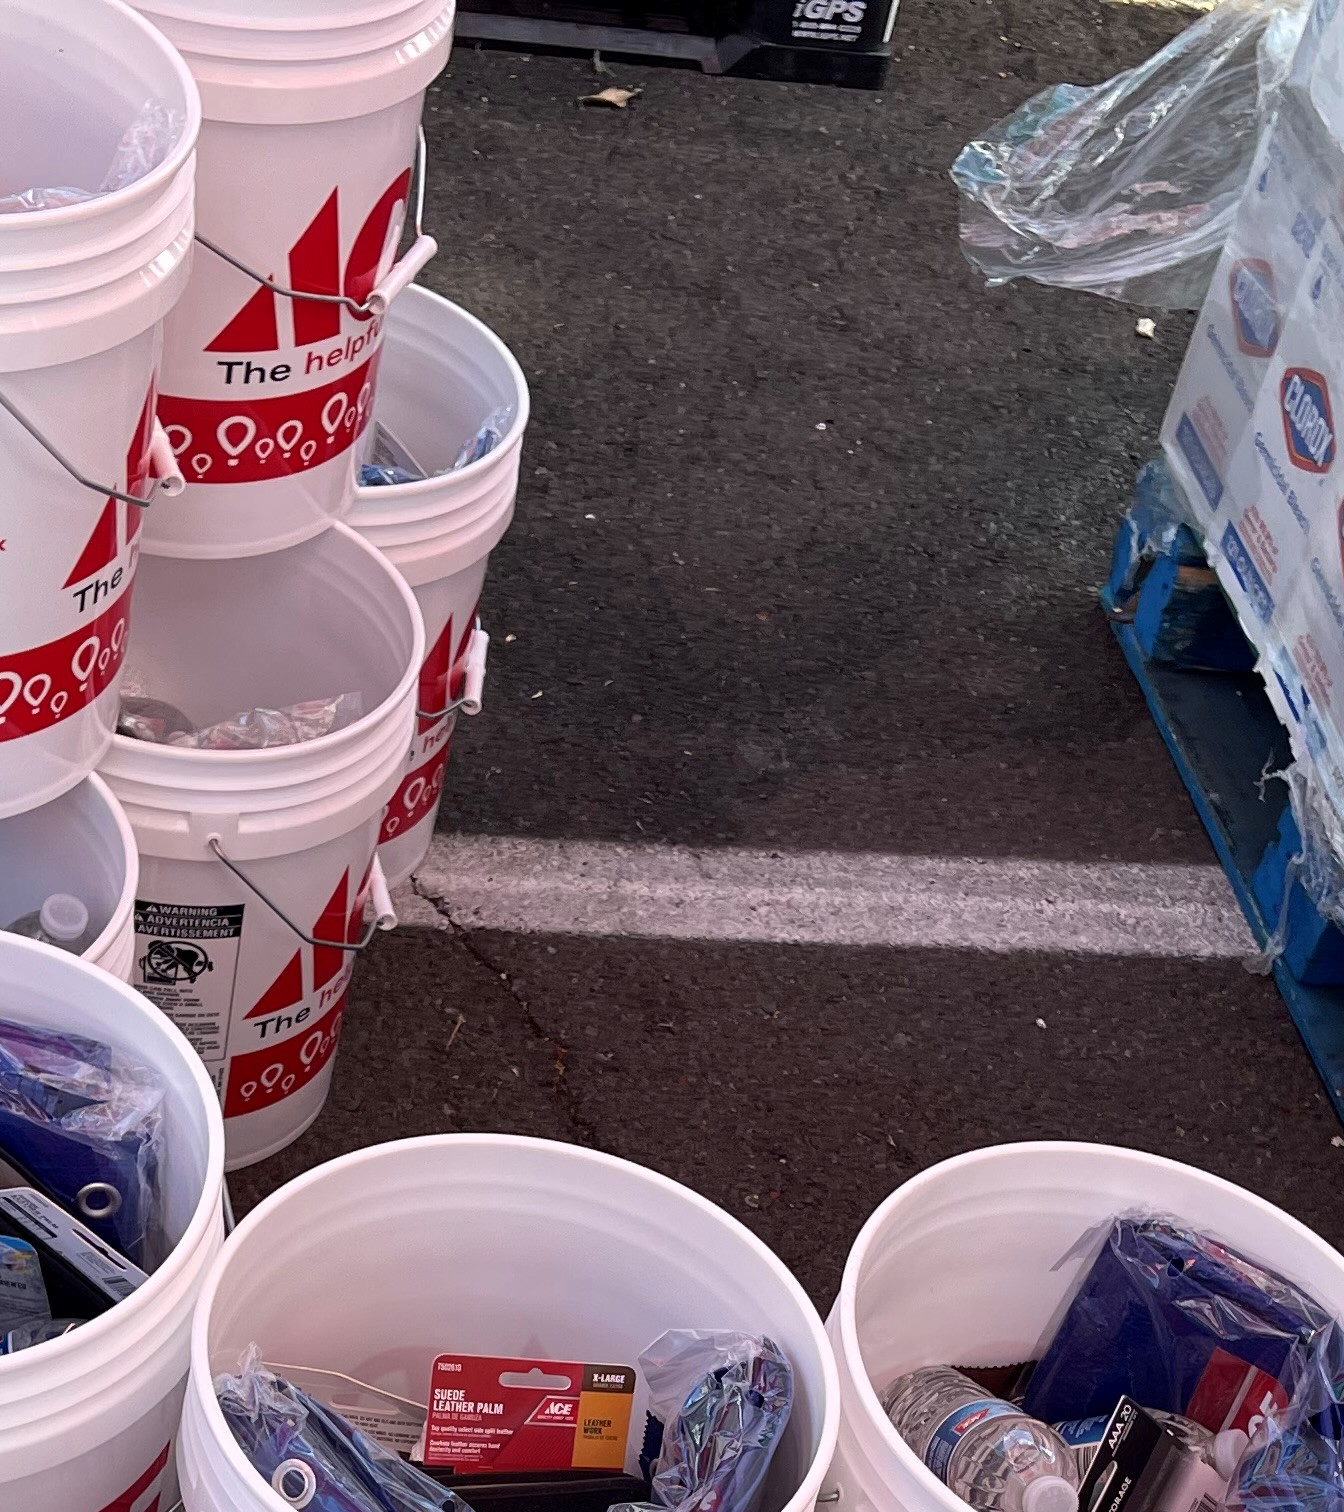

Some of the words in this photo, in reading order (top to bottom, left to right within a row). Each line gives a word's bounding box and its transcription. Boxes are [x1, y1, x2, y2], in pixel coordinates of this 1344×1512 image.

[217, 361, 292, 385] The
[1284, 373, 1336, 468] CLOROX
[73, 566, 124, 614] The
[158, 906, 218, 917] WARNING
[146, 915, 230, 928] ADVERTENCIA
[137, 925, 235, 938] AVERTISSEMENT
[253, 1007, 311, 1038] The
[592, 1373, 626, 1385] X-LARGE
[434, 1388, 466, 1401] SUEDE
[432, 1399, 474, 1413] LEATHER
[476, 1402, 504, 1416] PALM
[544, 1401, 573, 1416] ACE
[582, 1419, 612, 1429] LEATHER
[1107, 1420, 1125, 1451] AAA
[1118, 1402, 1134, 1424] 20
[582, 1427, 604, 1436] WORK
